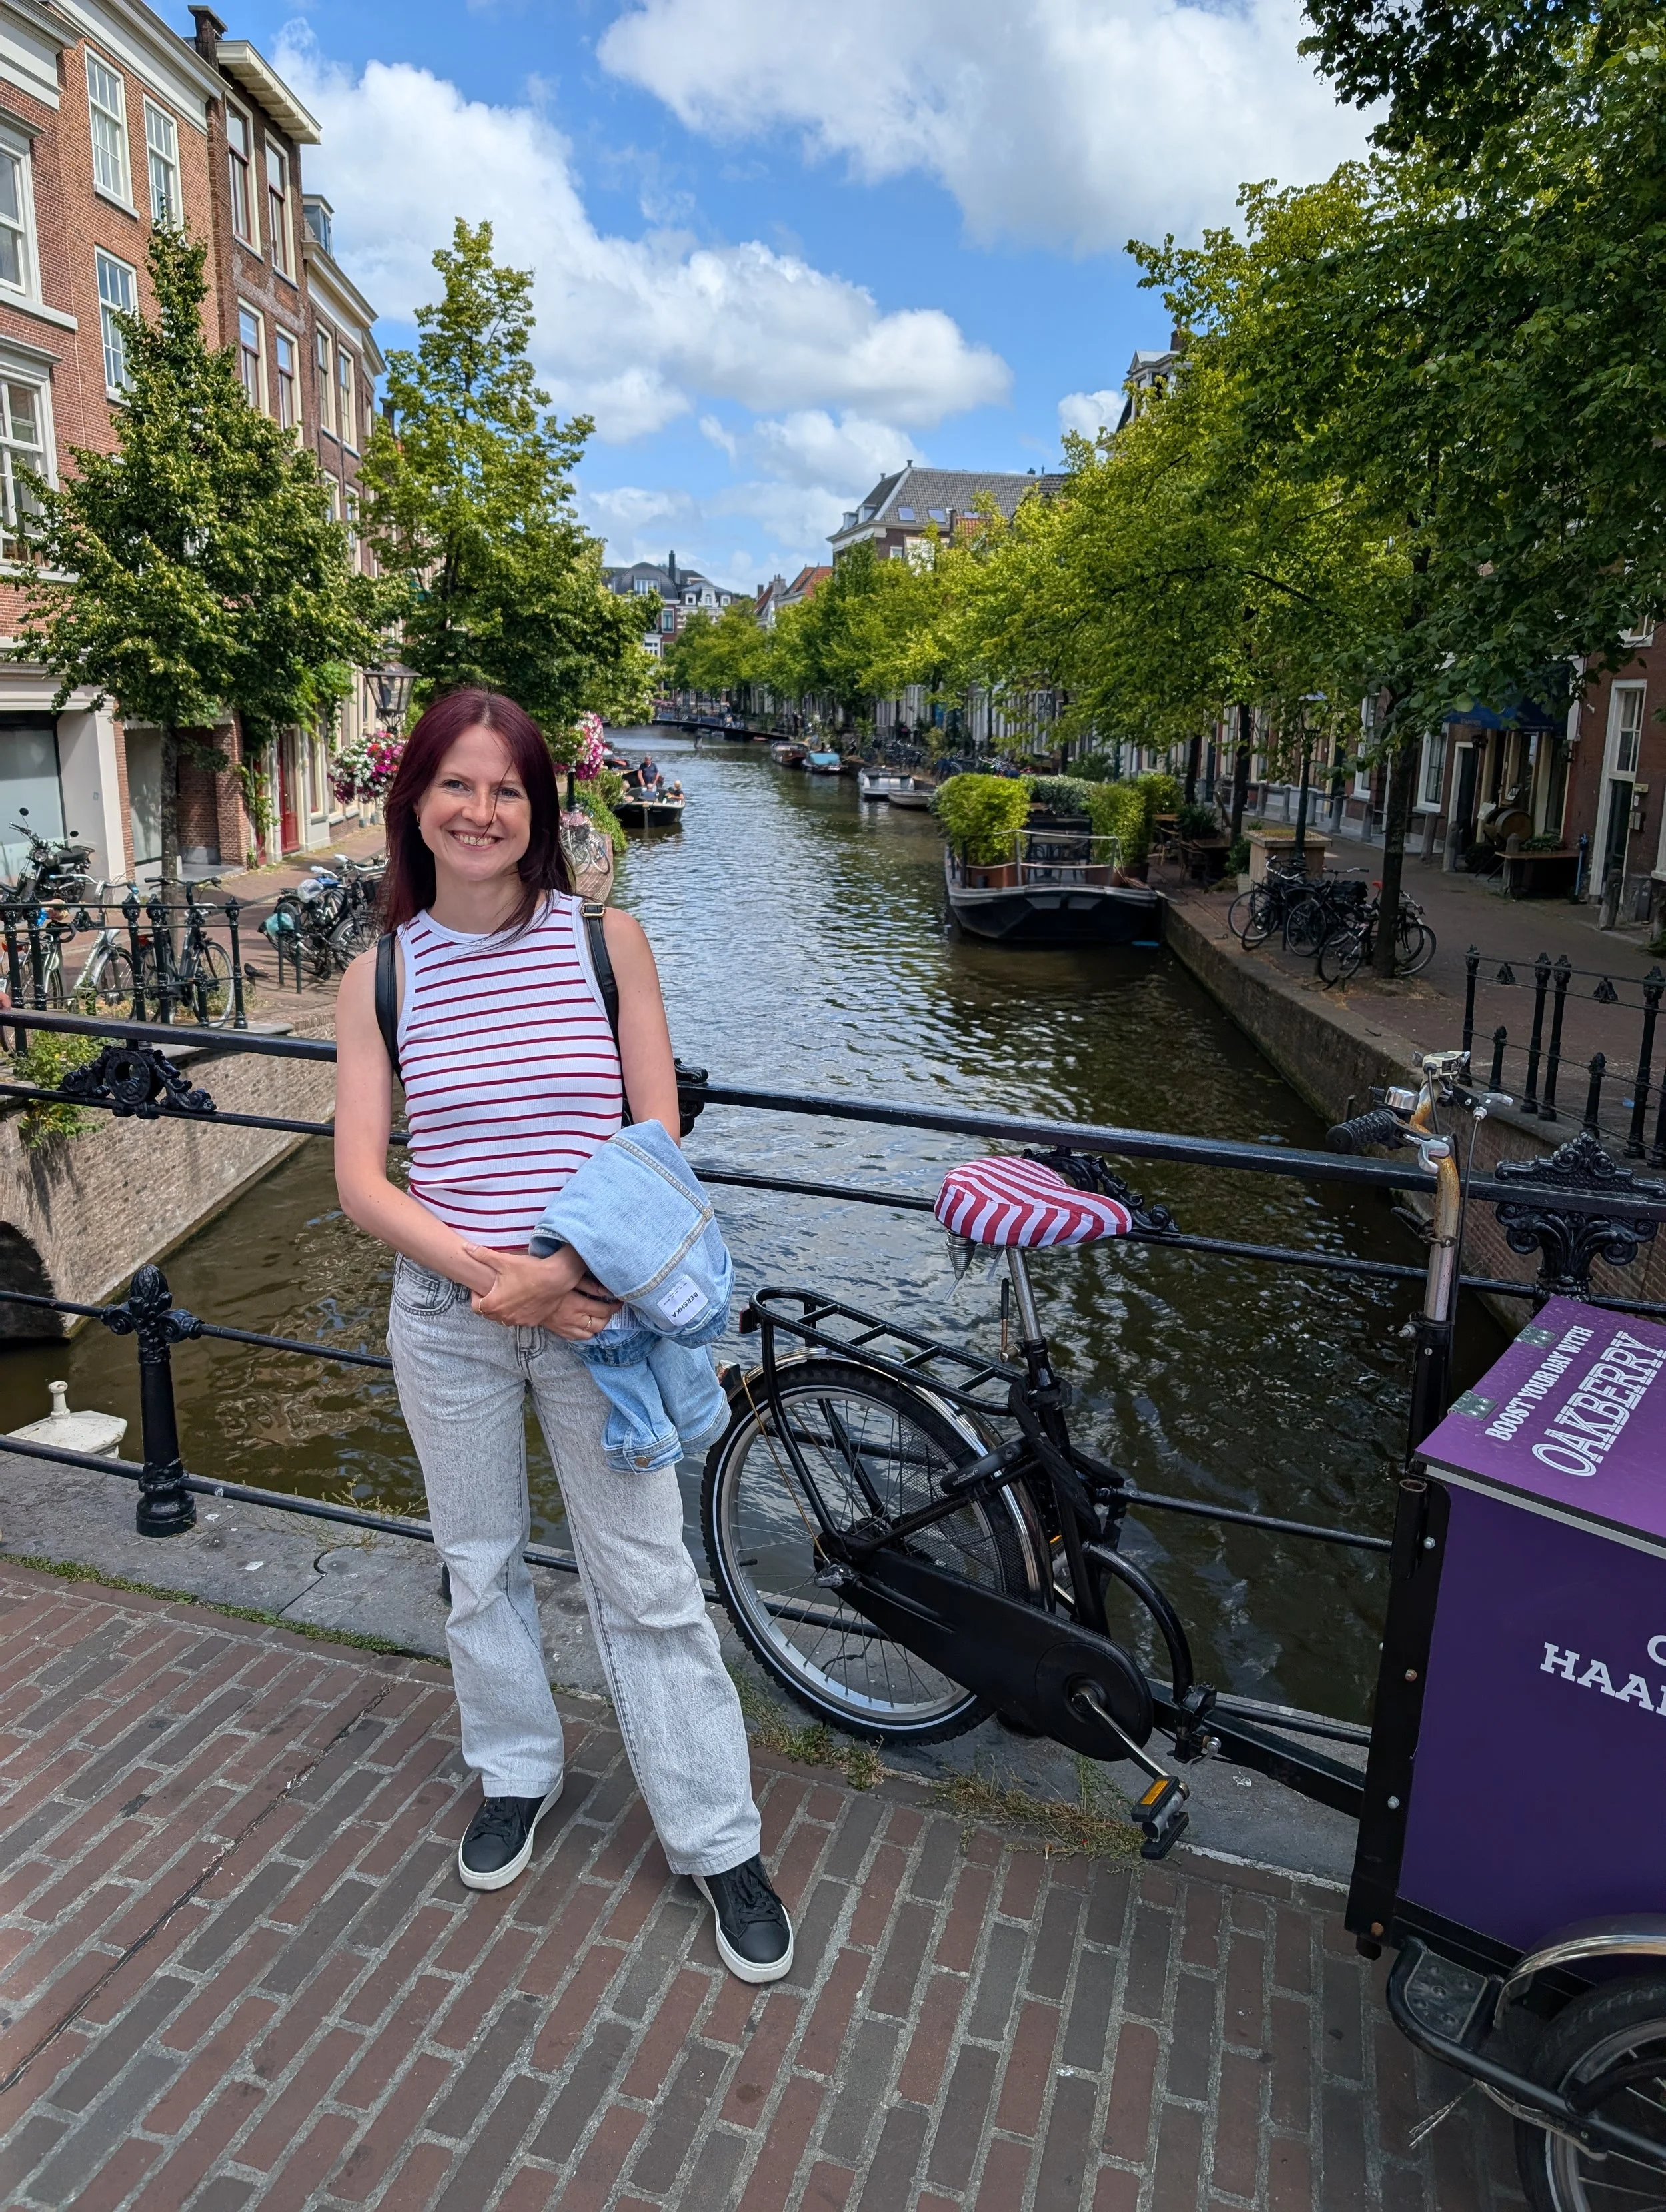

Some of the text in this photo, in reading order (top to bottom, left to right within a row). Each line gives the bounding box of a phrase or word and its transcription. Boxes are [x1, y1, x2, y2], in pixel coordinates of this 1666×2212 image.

[671, 1291, 698, 1318] BERSHKA
[1485, 1325, 1595, 1441] BOOST YOUR DAY WITH
[1531, 1330, 1666, 1476] OAKBERRY
